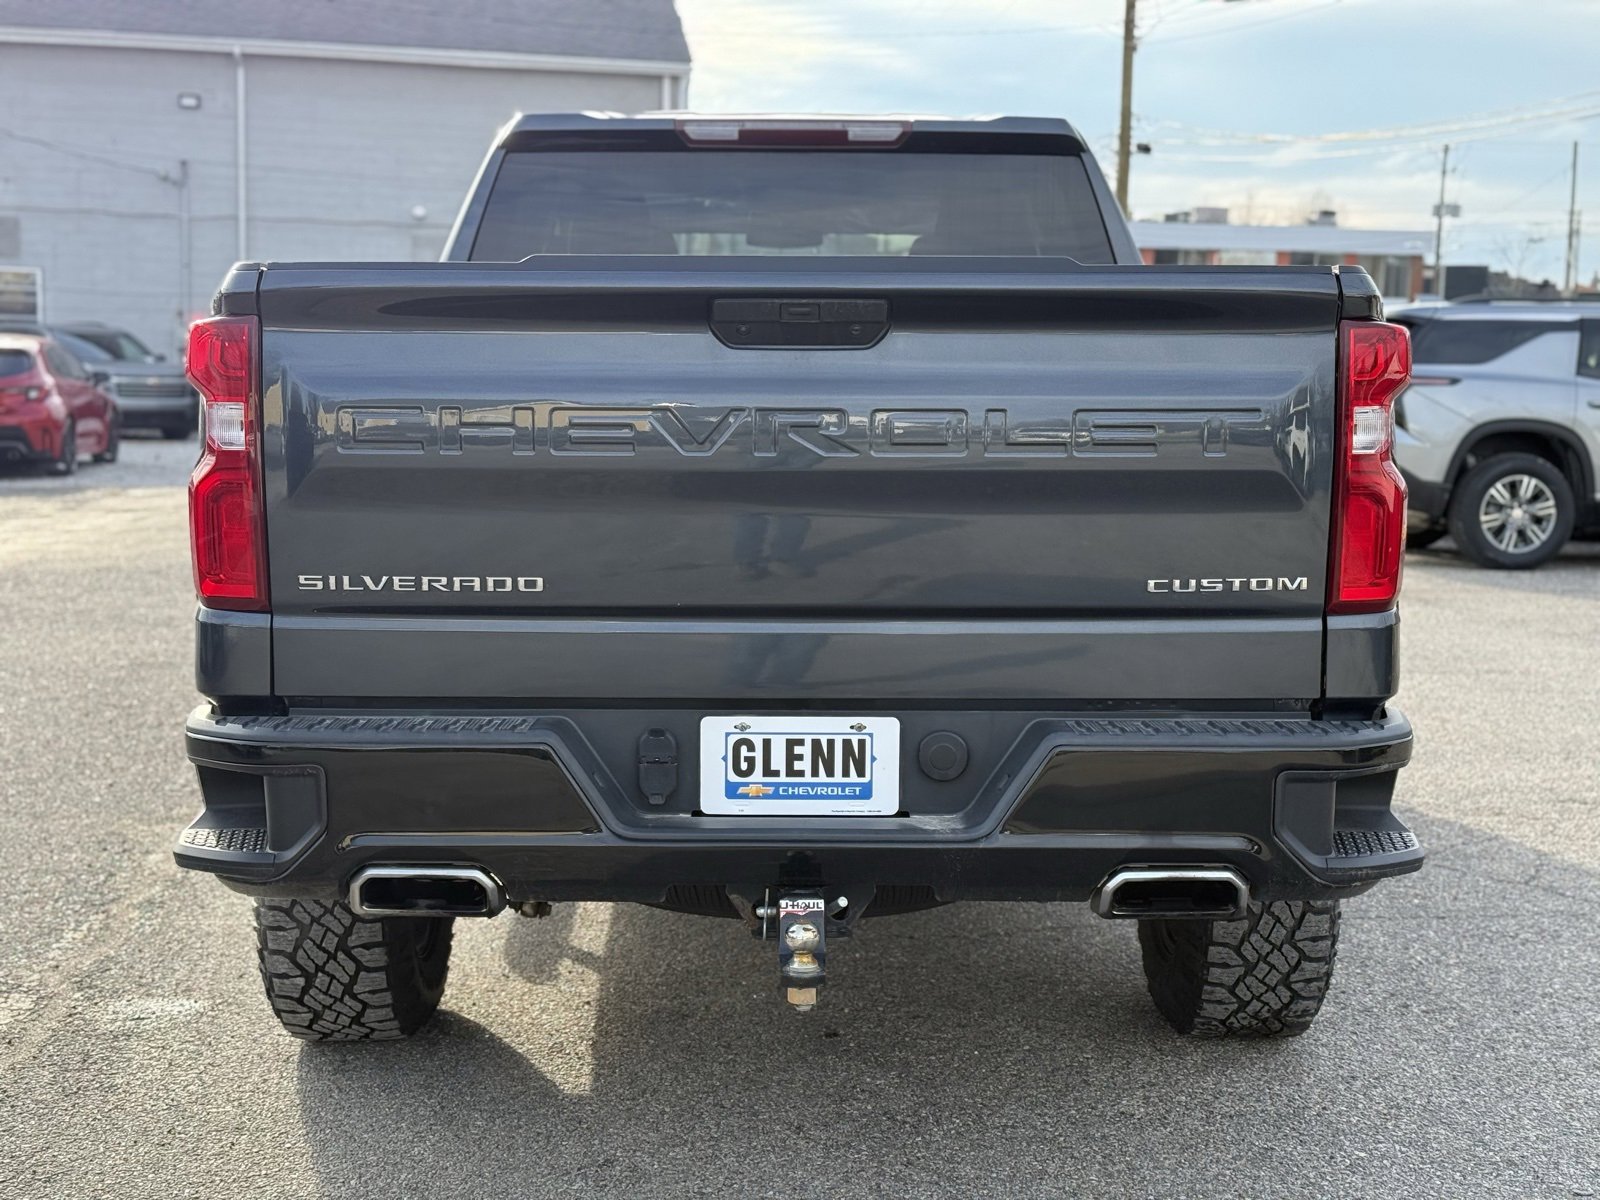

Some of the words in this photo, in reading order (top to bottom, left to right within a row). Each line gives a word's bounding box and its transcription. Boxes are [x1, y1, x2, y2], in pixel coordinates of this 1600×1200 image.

[336, 404, 1264, 458] CHEVROLET
[297, 574, 545, 592] SILVERADO
[1146, 576, 1309, 593] CUSTOM
[731, 737, 867, 779] GLENN
[779, 786, 863, 796] CHEVROLET
